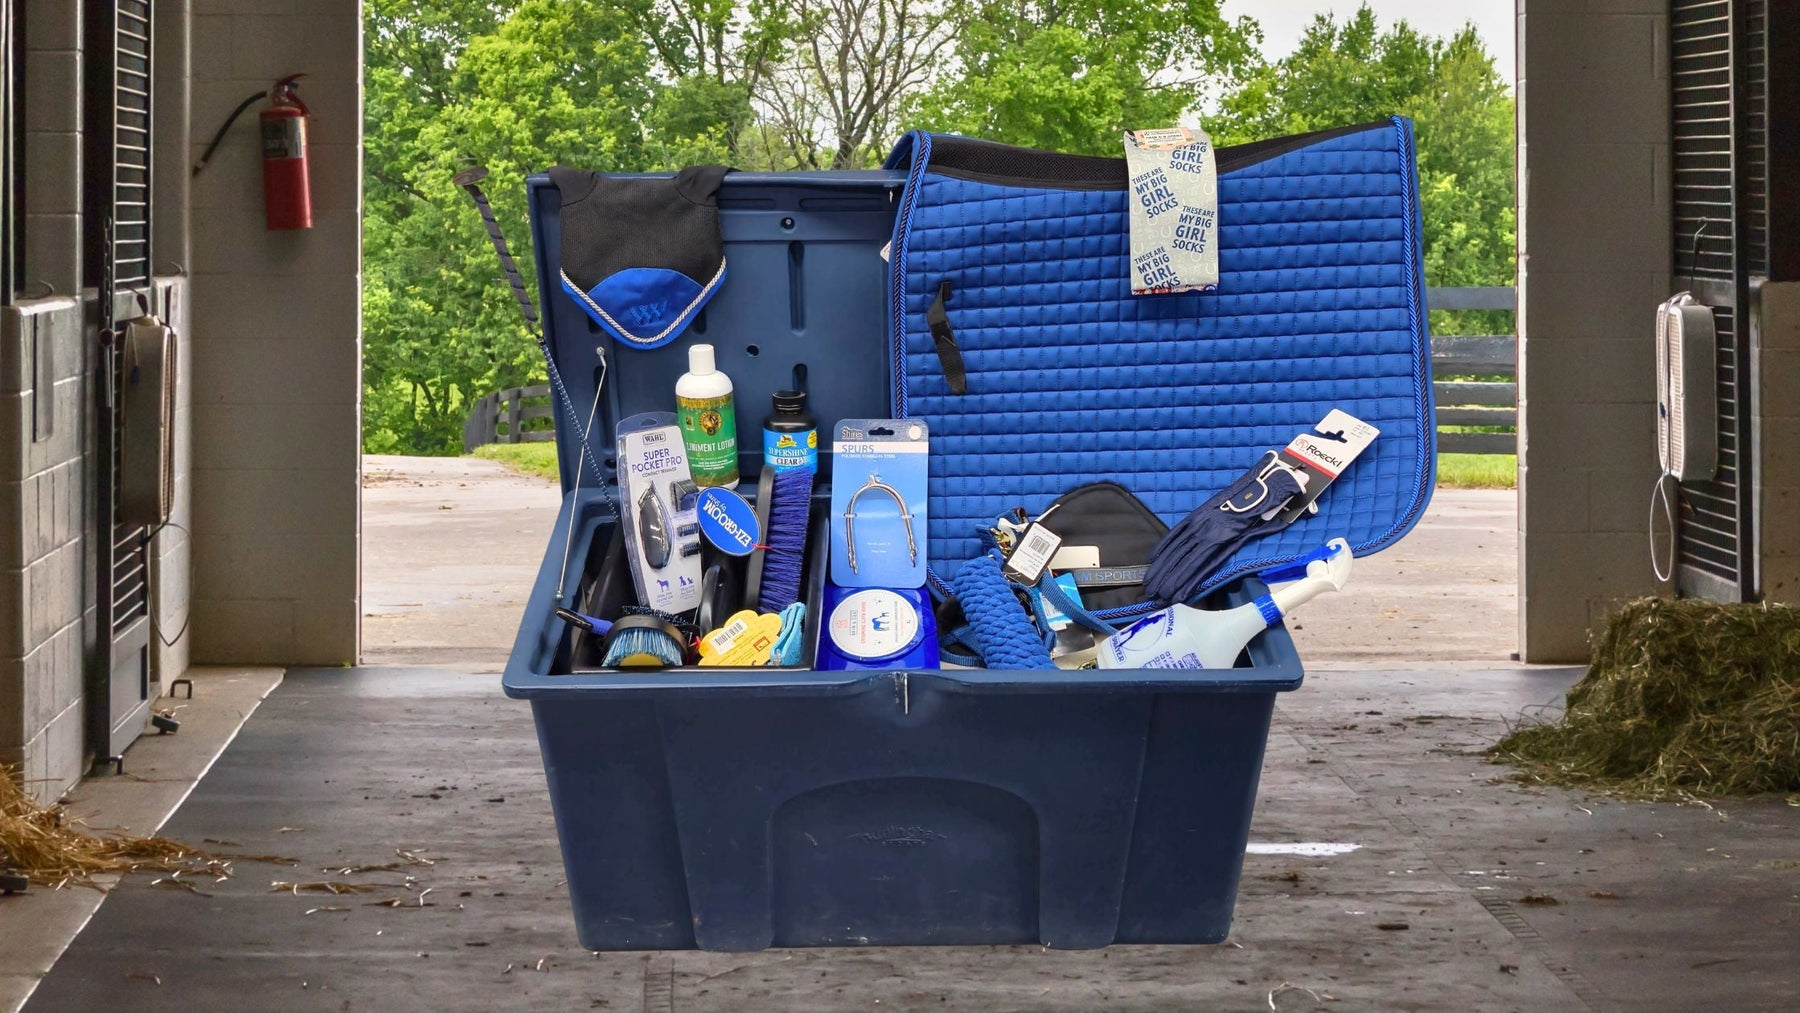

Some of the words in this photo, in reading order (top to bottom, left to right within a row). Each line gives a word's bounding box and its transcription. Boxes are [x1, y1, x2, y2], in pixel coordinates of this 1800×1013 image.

[1172, 149, 1203, 164] GIRL
[1190, 144, 1207, 153] BIG
[1169, 160, 1202, 174] SOCKS
[1132, 172, 1151, 184] THESE
[1151, 167, 1163, 177] ARE
[1135, 181, 1150, 195] MY
[1150, 174, 1167, 188] BIG
[1141, 185, 1174, 207] GIRL
[1146, 197, 1178, 218] SOCKS
[1182, 205, 1202, 215] THESE
[1202, 210, 1215, 218] ARE
[1178, 213, 1194, 224] MY
[1195, 216, 1212, 228] BIG
[1175, 224, 1206, 243] GIRL
[1172, 238, 1205, 254] SOCKS
[1134, 252, 1153, 264] THESE
[1153, 246, 1166, 256] ARE
[1137, 261, 1152, 274] MY
[1152, 253, 1170, 267] BIG
[1143, 265, 1176, 286] GIRL
[644, 434, 664, 442] WAHL
[643, 448, 670, 461] SUPER
[686, 441, 716, 452] LINIMENT
[842, 444, 874, 454] SPURS
[776, 457, 798, 465] CLEAR
[1306, 444, 1343, 467] Roeckl
[632, 459, 664, 473] POCKET
[666, 455, 682, 467] PRO
[720, 503, 727, 512] by
[703, 499, 753, 547] EZI-GROOM
